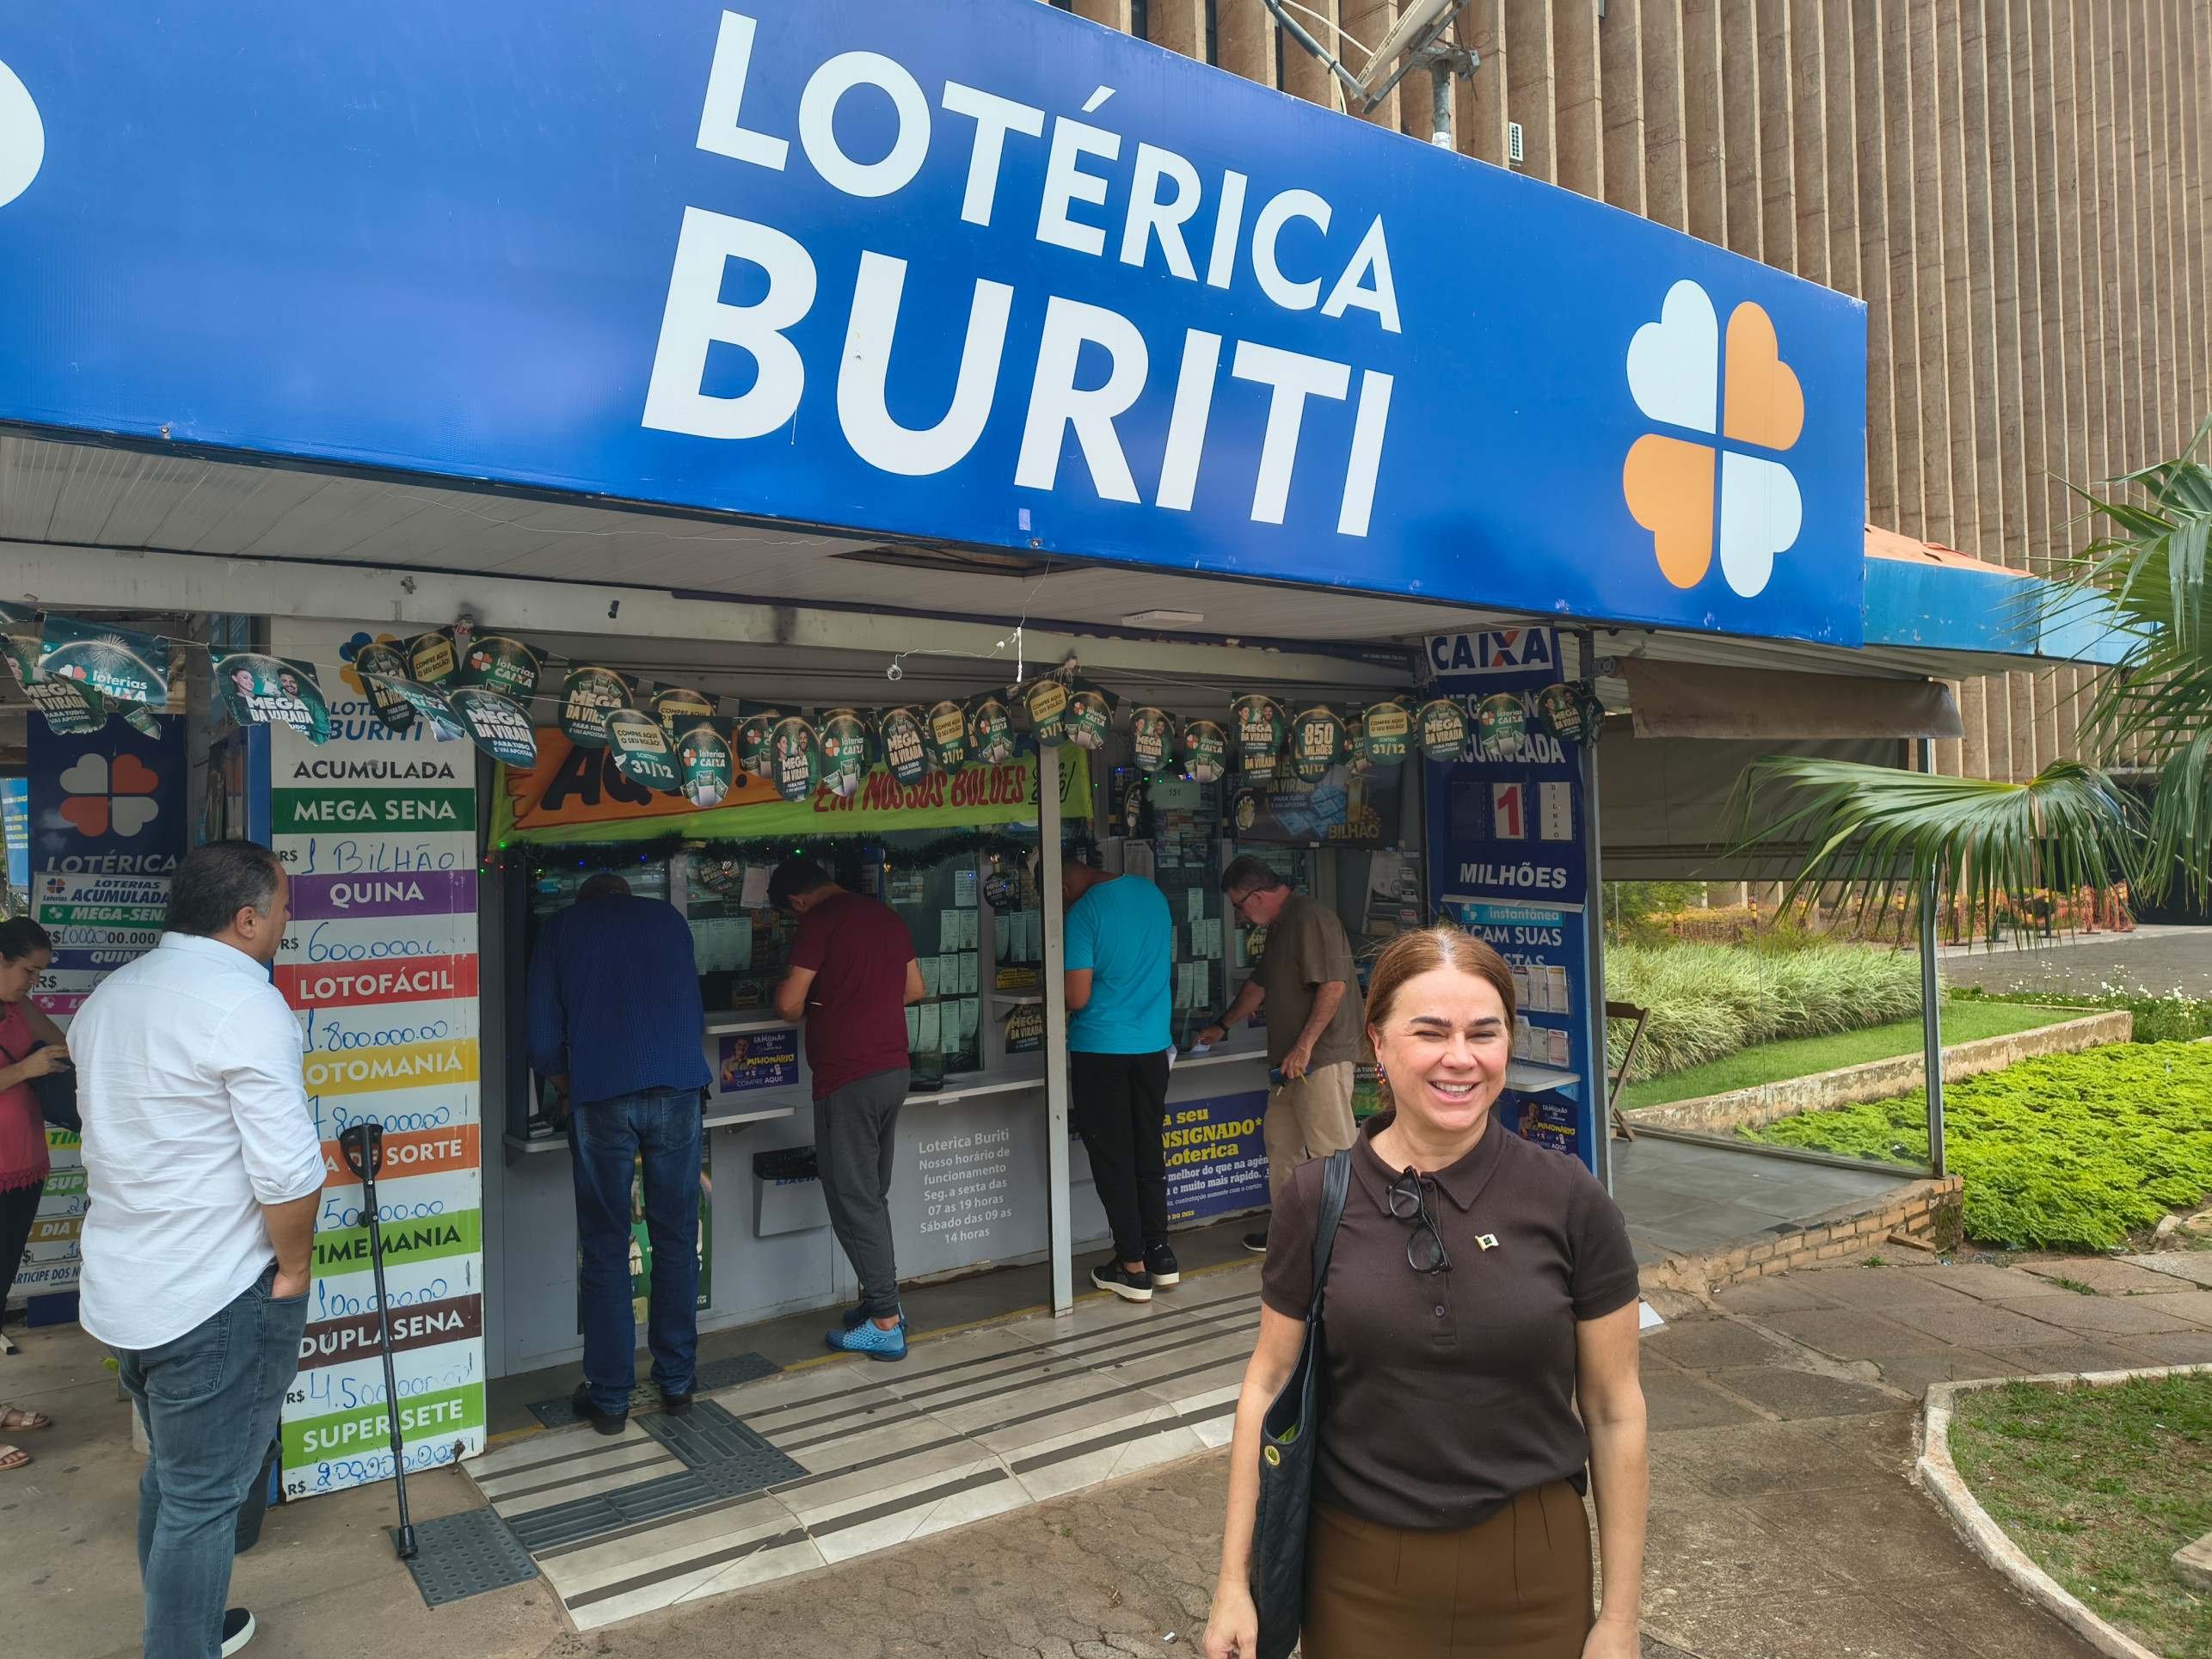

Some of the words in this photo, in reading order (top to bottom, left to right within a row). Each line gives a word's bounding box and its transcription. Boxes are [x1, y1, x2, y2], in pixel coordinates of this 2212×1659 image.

[696, 9, 1402, 334] LOTÉRICA
[641, 206, 1393, 538] BURITI
[1430, 627, 1551, 670] CAIXA
[496, 657, 535, 679] loterias
[93, 670, 148, 690] loterias
[495, 667, 532, 688] CAIXA
[246, 696, 309, 711] MEGA
[569, 690, 621, 709] MEGA
[249, 710, 268, 723] DA
[466, 709, 529, 728] MEGA
[1424, 717, 1462, 732] MEGA
[1553, 709, 1578, 722] MEGA
[1241, 723, 1273, 732] MEGA
[1304, 723, 1334, 745] 850
[888, 731, 920, 752] MEGA
[1136, 734, 1162, 747] MEGA
[1201, 744, 1223, 754] CAIXA
[1372, 743, 1405, 754] 31/12
[699, 749, 726, 759] loterias
[1305, 744, 1333, 756] MILHÕES
[293, 760, 455, 778] ACUMULADA
[630, 760, 675, 779] 31/12
[700, 759, 725, 767] CAIXA
[782, 755, 808, 771] MEGA
[294, 800, 378, 820] MEGA
[385, 800, 457, 820] SENA
[1497, 786, 1520, 835] 1
[46, 850, 177, 873] LOTÉRICA
[95, 880, 162, 888] LOTERIAS
[1459, 862, 1567, 888] MILHÕES
[329, 882, 425, 908] QUINA
[1490, 906, 1559, 920] instantânea
[280, 937, 298, 950] R$
[1515, 928, 1562, 946] SUAS
[36, 976, 57, 988] R$
[301, 967, 454, 999] LOTOFÁCIL
[1177, 1109, 1209, 1124] seu
[974, 1128, 1010, 1146] Buriti
[386, 1139, 462, 1165] SORTE
[919, 1158, 953, 1171] Nosso
[955, 1150, 994, 1165] horário
[998, 1146, 1011, 1157] de
[924, 1164, 1006, 1185] funcionamento
[1168, 1169, 1199, 1182] melhor
[1202, 1165, 1214, 1175] do
[1216, 1162, 1232, 1175] que
[1234, 1159, 1246, 1170] na
[958, 1182, 986, 1195] sexta
[989, 1178, 1007, 1189] das
[1181, 1179, 1206, 1193] muito
[1207, 1176, 1228, 1187] mais
[928, 1206, 942, 1216] 07
[959, 1200, 972, 1211] 19
[974, 1195, 1004, 1207] horas
[964, 1214, 983, 1226] das
[985, 1209, 998, 1221] 09
[40, 1222, 70, 1238] DIA
[945, 1232, 957, 1244] 14
[960, 1228, 990, 1242] horas
[52, 1268, 71, 1280] DOS
[298, 1326, 392, 1358] DUPLA
[393, 1309, 464, 1340] SENA
[286, 1390, 304, 1404] R$
[304, 1418, 391, 1453] SUPER
[401, 1398, 464, 1431] SETE
[287, 1481, 306, 1496] R$
